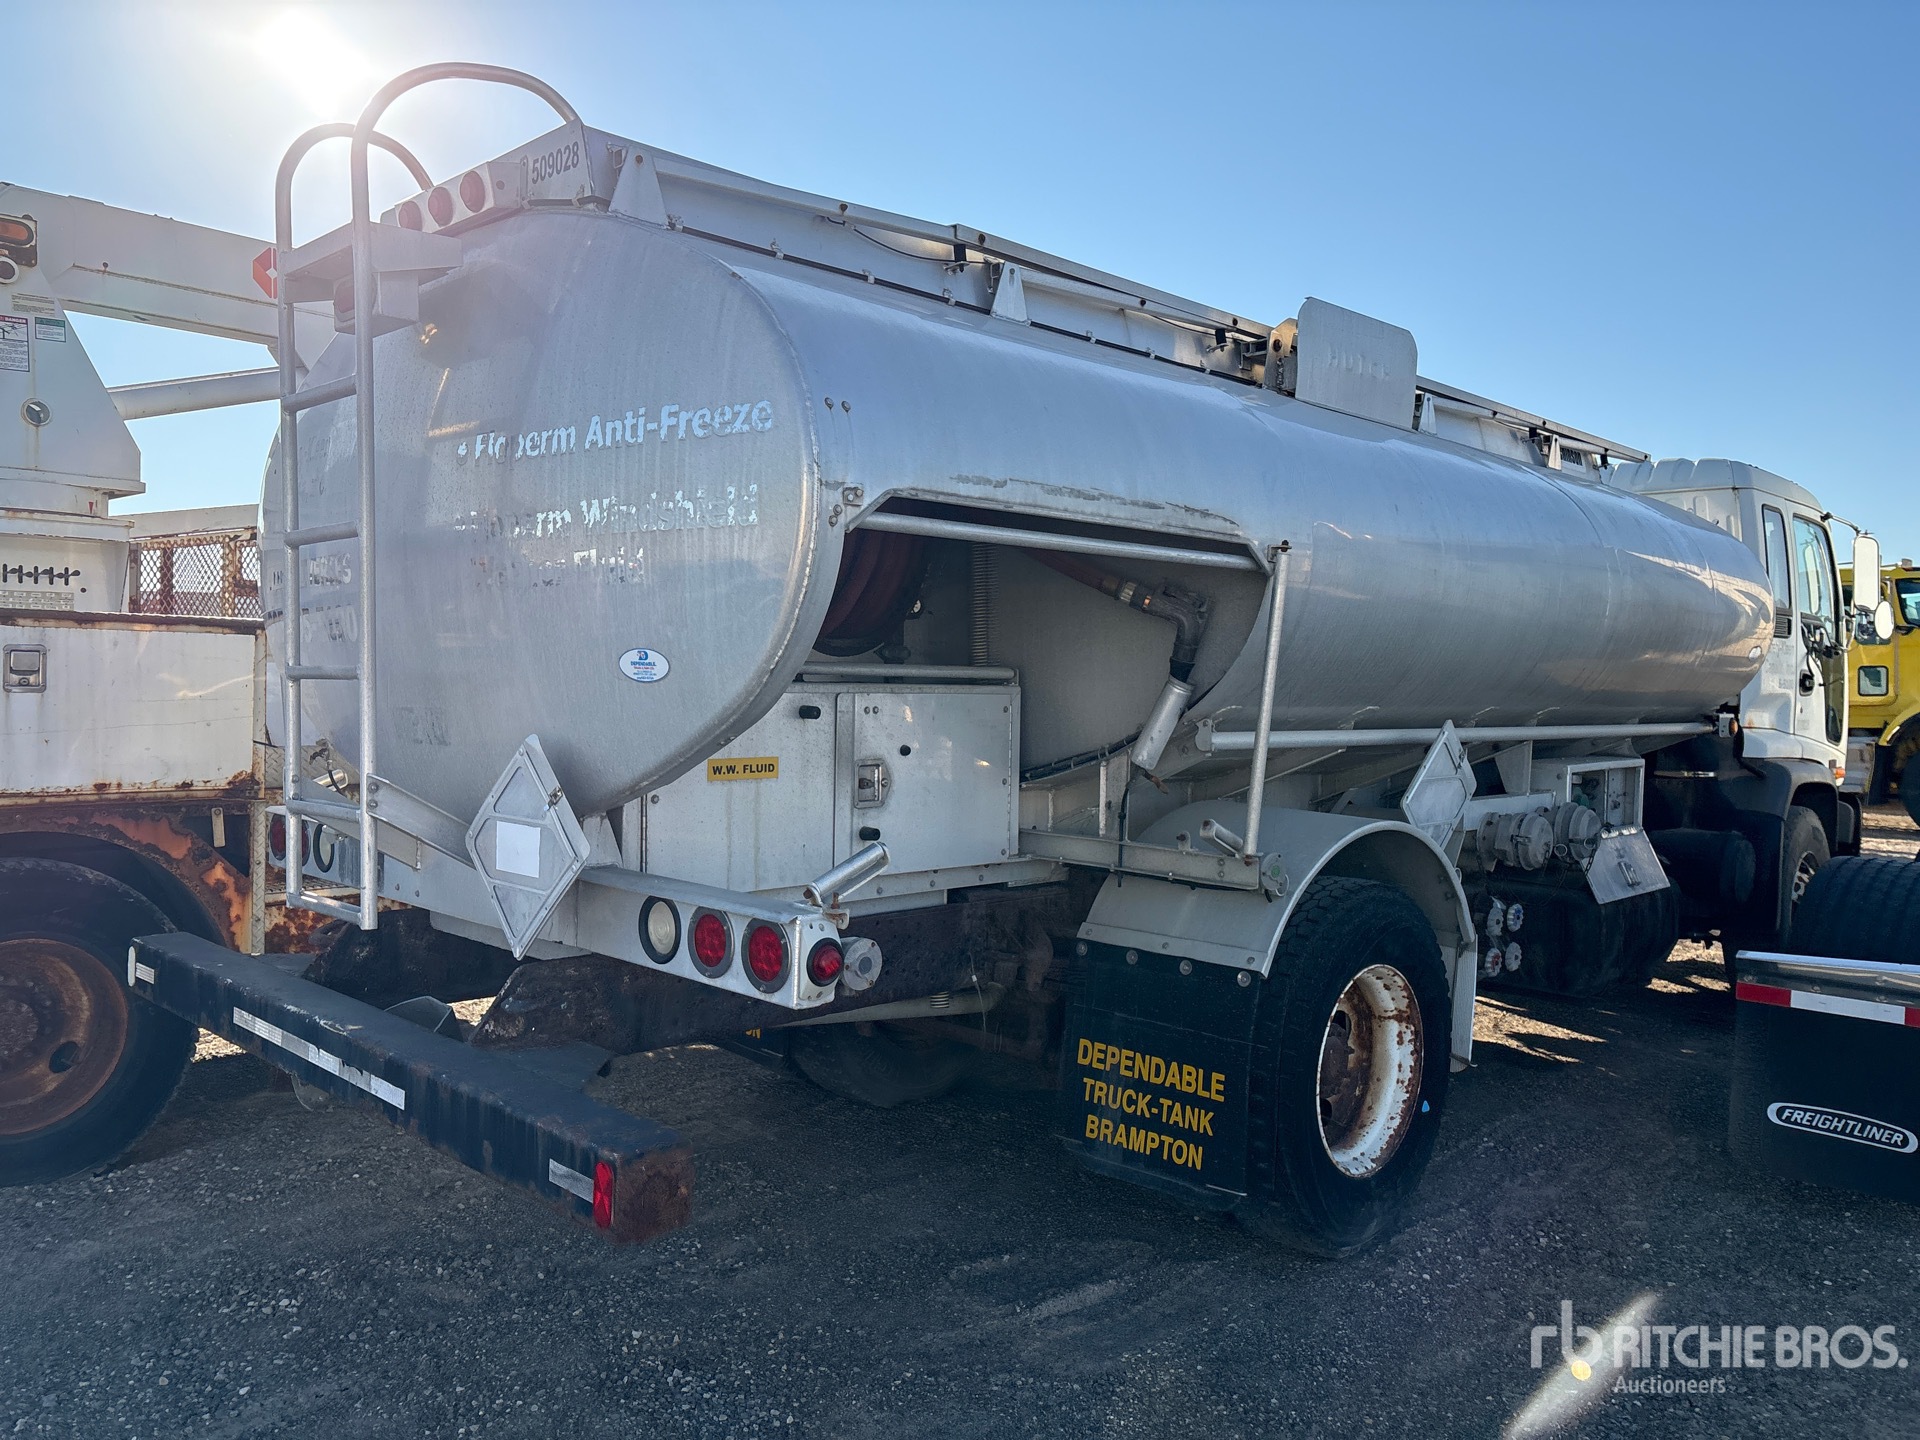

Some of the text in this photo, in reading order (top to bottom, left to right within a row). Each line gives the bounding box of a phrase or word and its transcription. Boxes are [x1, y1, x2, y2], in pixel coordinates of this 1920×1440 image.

[531, 141, 579, 185] 509028
[584, 400, 775, 450] Anti-Freeze
[712, 763, 775, 775] W.W. FLUID
[1077, 1038, 1225, 1102] DEPENDABLE
[1083, 1077, 1214, 1137] TRUCK-TANK
[1781, 1108, 1904, 1146] FREIGHTLINER
[1085, 1114, 1203, 1170] BRAMPTON
